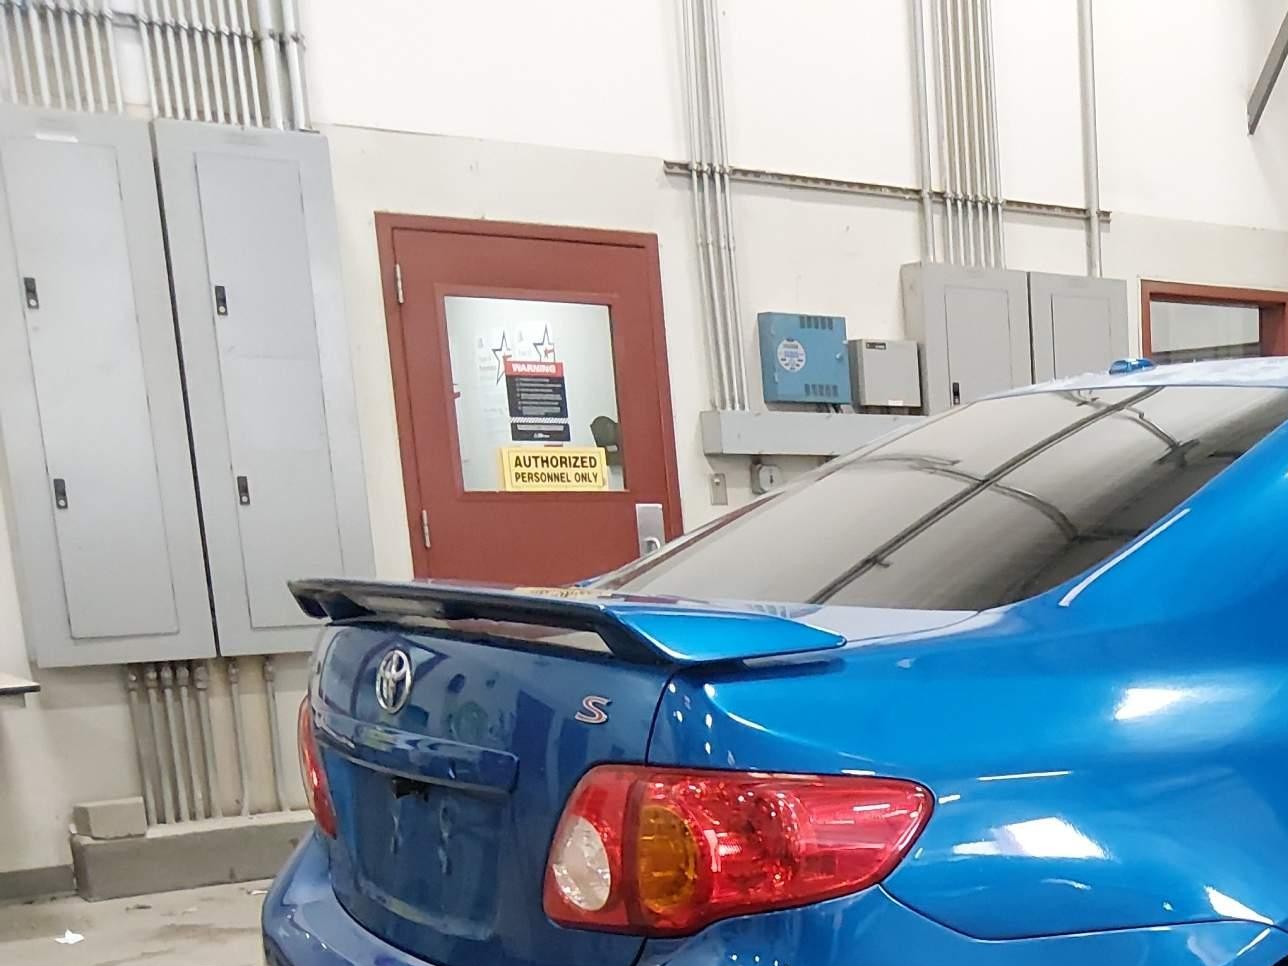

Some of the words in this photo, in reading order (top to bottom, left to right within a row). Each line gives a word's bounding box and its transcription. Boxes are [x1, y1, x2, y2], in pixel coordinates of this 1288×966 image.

[511, 363, 557, 374] WARNING
[514, 455, 598, 469] AUTHORIZED
[514, 471, 571, 483] PERSONNEL
[574, 472, 598, 483] ONLY
[574, 695, 610, 724] S
